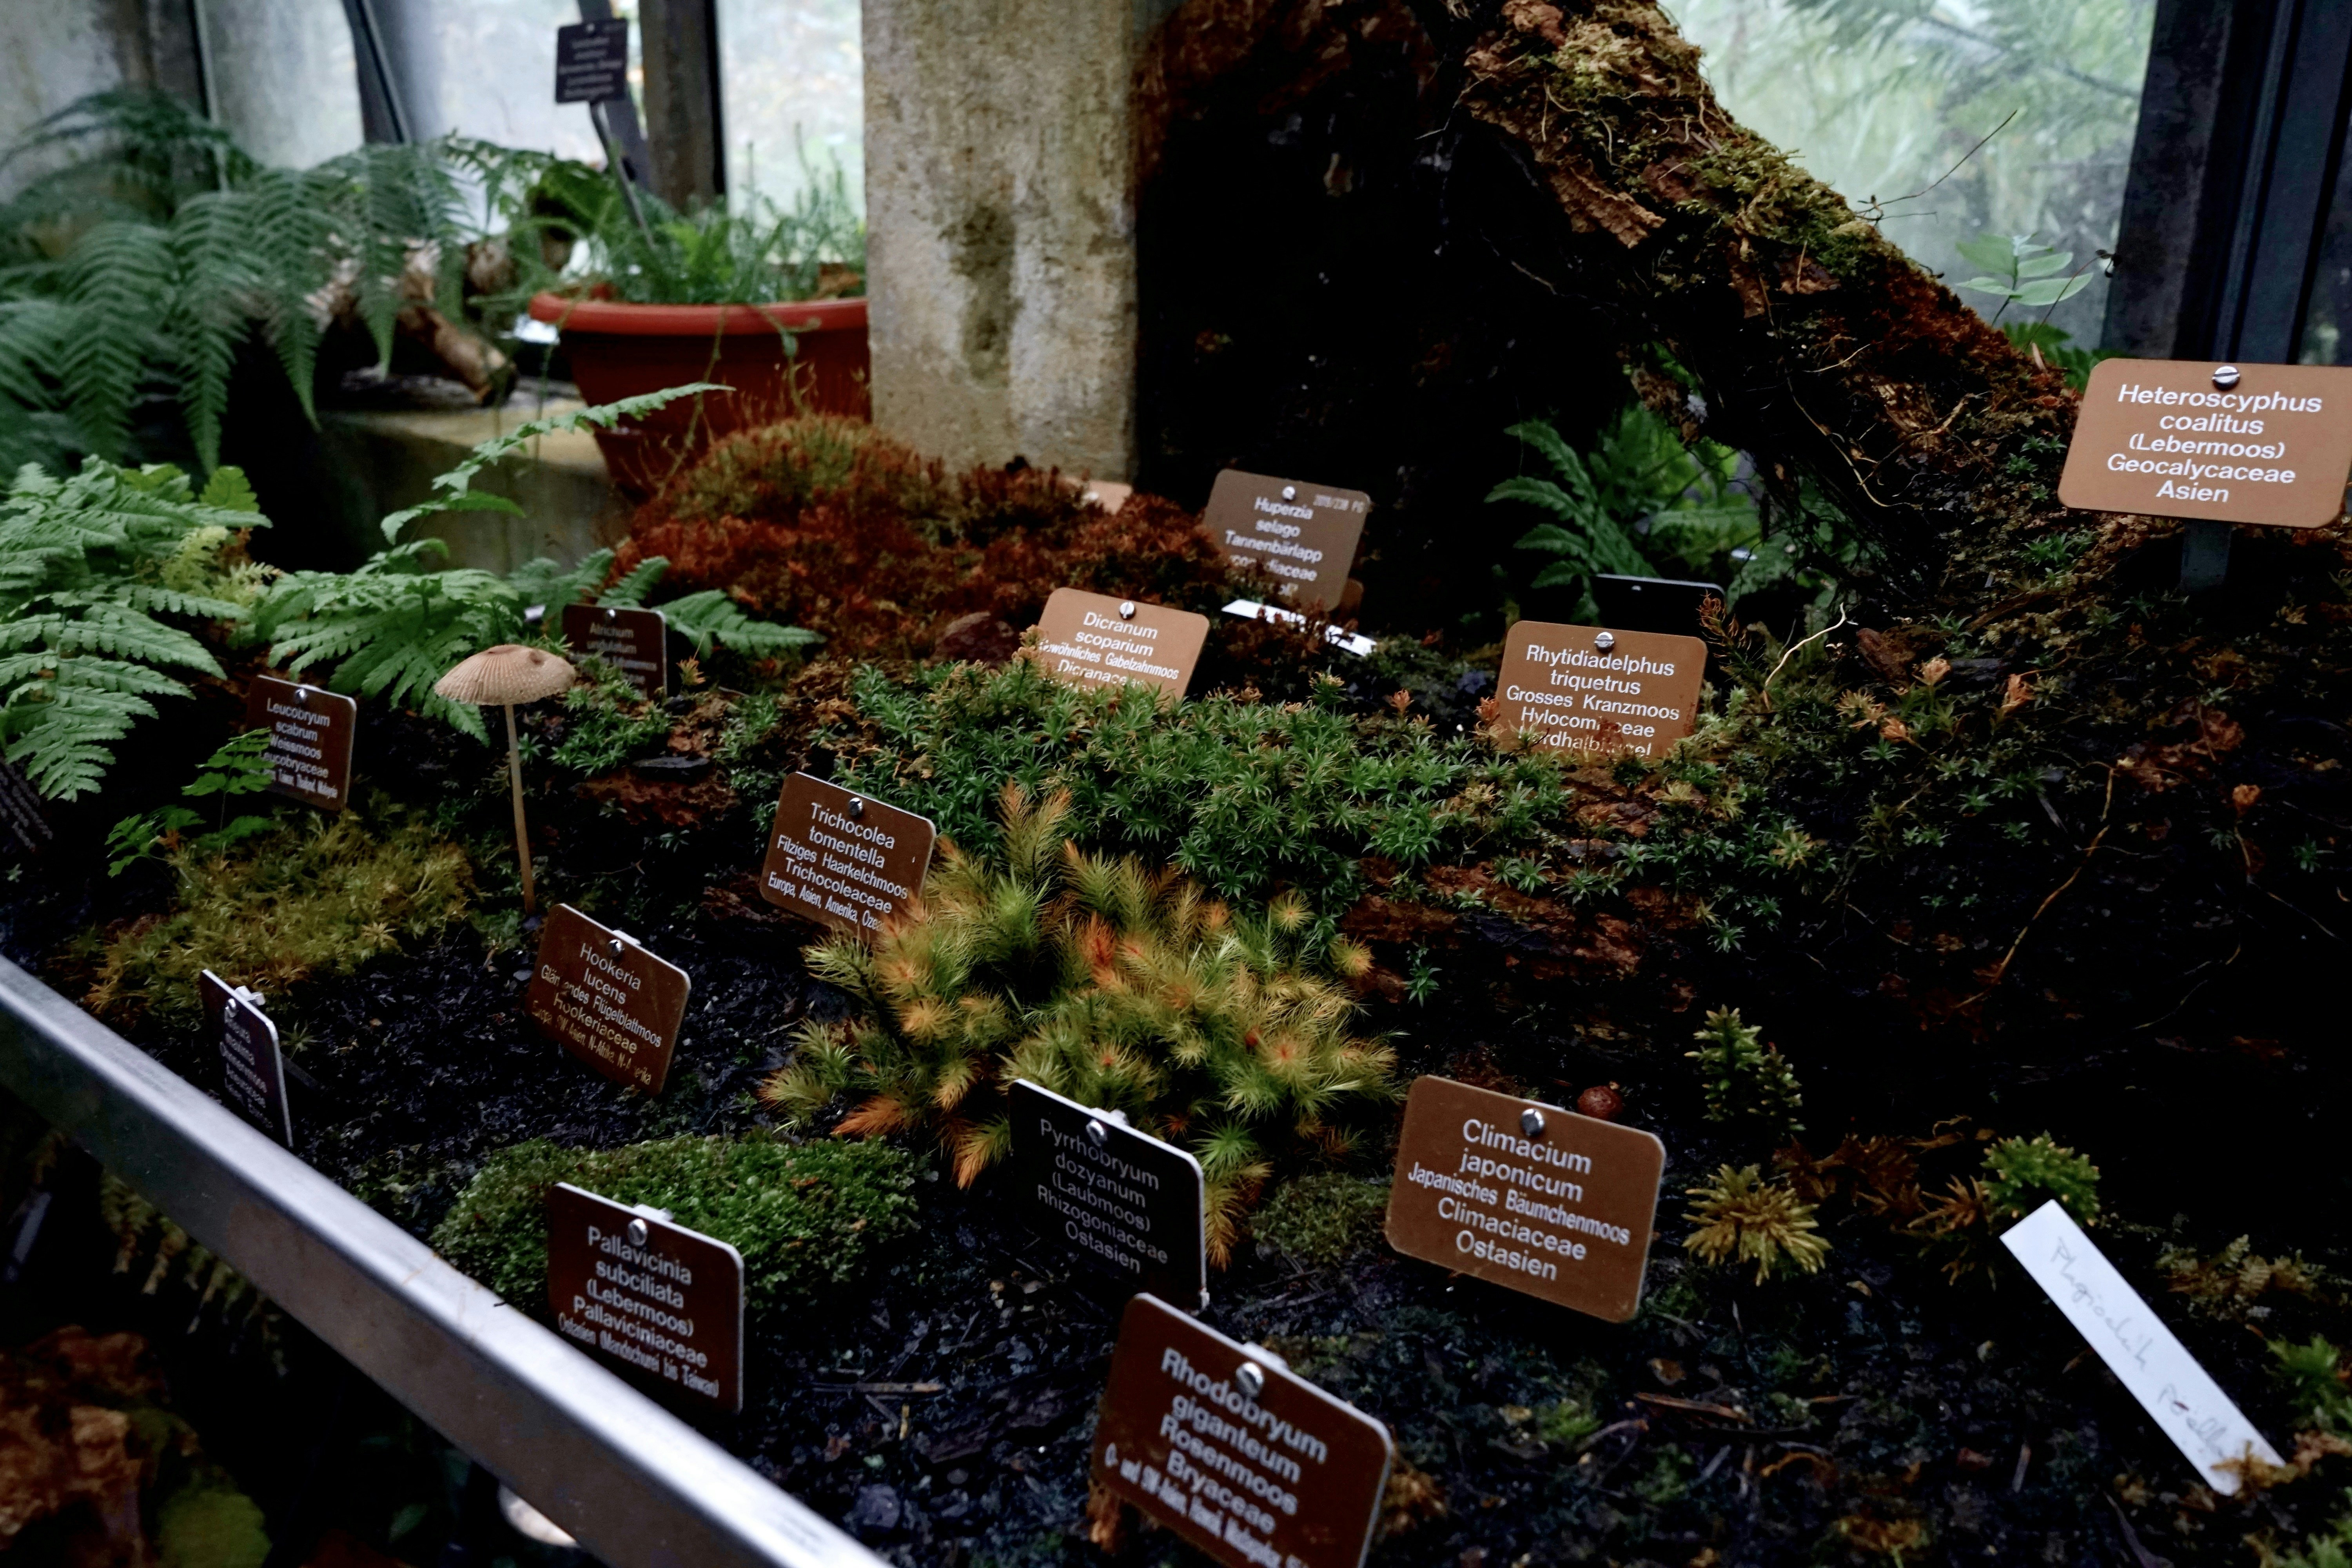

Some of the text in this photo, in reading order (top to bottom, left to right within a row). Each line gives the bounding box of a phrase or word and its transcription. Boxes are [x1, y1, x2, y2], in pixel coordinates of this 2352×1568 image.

[2118, 384, 2323, 413] Heteroscyphus
[2129, 433, 2285, 459] (Lebermoos)
[2160, 414, 2264, 435] coalitus
[2108, 454, 2296, 483] Geocalycaceae
[2156, 480, 2229, 503] Asien
[1254, 497, 1314, 520] Huperzia
[1256, 519, 1301, 538] selago
[1076, 631, 1154, 657] scoparium
[1083, 612, 1158, 640] Dicranum
[1105, 652, 1179, 680] Gabelzahnmoos
[1526, 645, 1675, 676] Rhytidiadelphus
[1551, 671, 1641, 695] triquetrus
[267, 697, 330, 727] Leucobryum
[1507, 685, 1680, 720] Grosses Kranzmoos
[276, 721, 318, 742] scabrum
[809, 826, 885, 869] tomentella
[811, 802, 895, 849] Trichocolea
[777, 834, 909, 900] Filziges Haarkelchmoos
[785, 857, 892, 914] Trichocoleaceae
[768, 871, 796, 898] Europa,
[799, 884, 822, 909] Asien,
[825, 896, 858, 924] Amerika,
[579, 943, 642, 991] Hookeria
[584, 968, 627, 1005] lucens
[593, 995, 662, 1047] Flügelblattmoos
[1041, 1118, 1159, 1191] Pyrrhobryum
[1463, 1119, 1592, 1174] Climacium
[1056, 1152, 1145, 1208] dozyanum
[1459, 1148, 1584, 1202] japonicum
[1037, 1184, 1168, 1264] Rhizogoniaceae
[1053, 1171, 1150, 1232] (Laubmoos)
[1408, 1161, 1631, 1246] Japanisches Bäumchenmoos
[1065, 1221, 1140, 1274] Ostasien
[1438, 1197, 1586, 1260] Climaciaceae
[588, 1226, 692, 1286] Pallavicinia
[1456, 1230, 1557, 1281] Ostasien
[587, 1278, 694, 1338] (Lebermoos)
[595, 1260, 684, 1309] subciliata
[573, 1296, 708, 1368] Pallaviciniaceae
[1161, 1347, 1328, 1465] Rhodobryum
[1160, 1413, 1299, 1516] Rosenmoos
[1172, 1394, 1301, 1484] giganteum
[1167, 1449, 1276, 1535] Bryaceae
